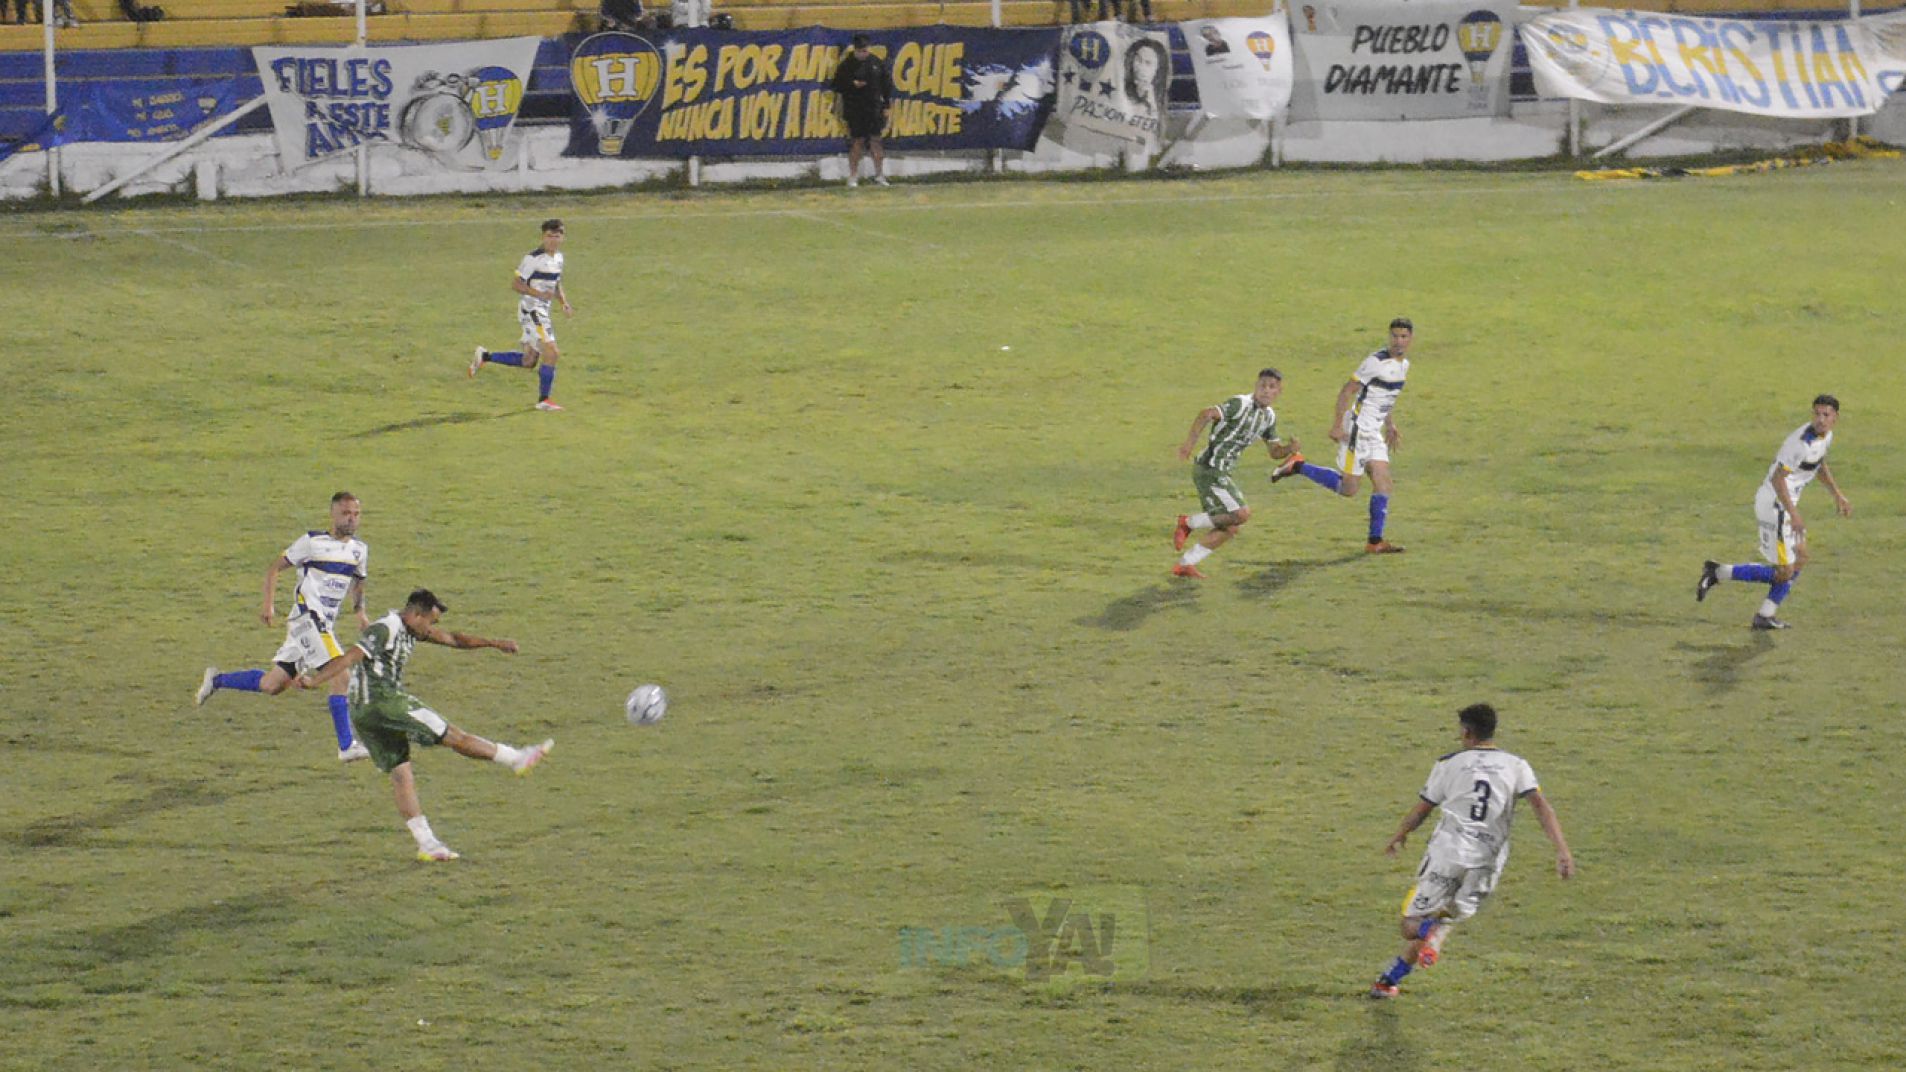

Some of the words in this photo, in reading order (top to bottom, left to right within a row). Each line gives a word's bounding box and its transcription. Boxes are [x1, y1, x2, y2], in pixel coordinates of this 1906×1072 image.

[1079, 37, 1099, 61] H
[1352, 23, 1450, 54] PUEBLO
[270, 56, 393, 99] FIELES
[592, 57, 640, 98] H
[661, 42, 709, 110] ES
[713, 43, 783, 92] POR
[893, 41, 964, 98] QUE
[1324, 64, 1462, 95] DIAMANTE
[477, 83, 510, 114] H
[656, 96, 735, 142] NUNCA
[739, 90, 786, 141] VOY
[782, 89, 802, 140] A
[1470, 780, 1491, 821] 3
